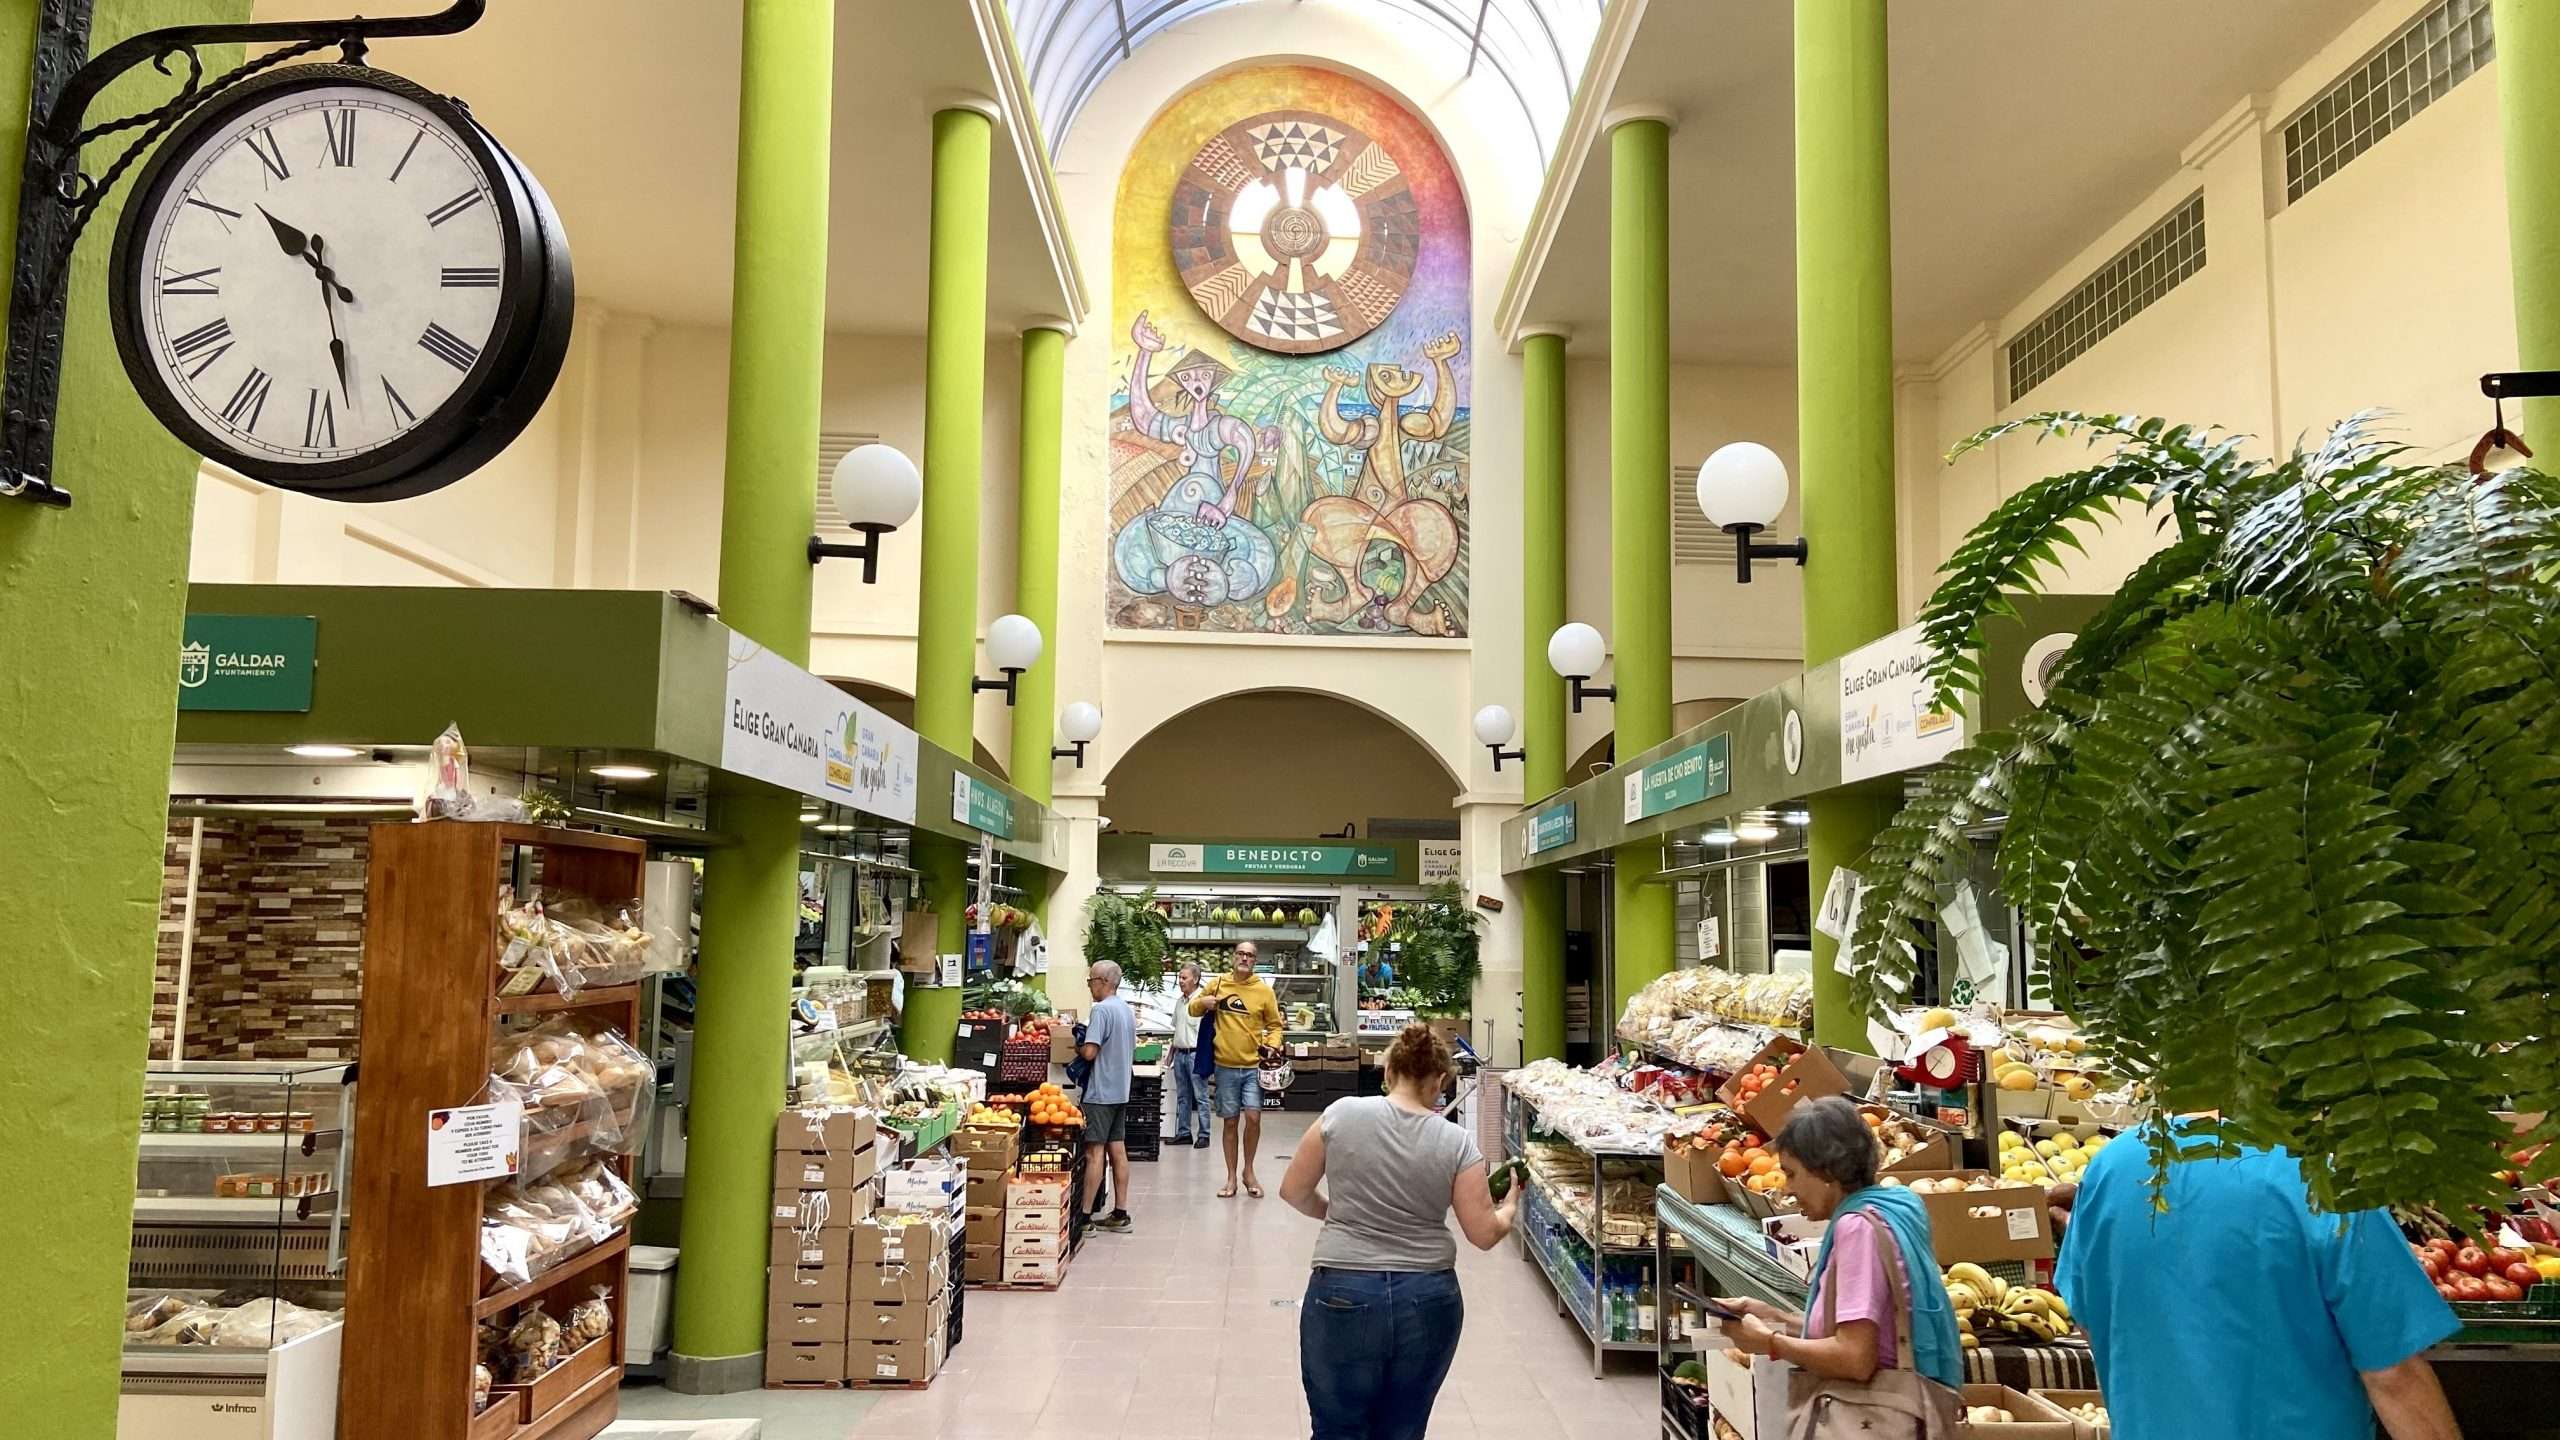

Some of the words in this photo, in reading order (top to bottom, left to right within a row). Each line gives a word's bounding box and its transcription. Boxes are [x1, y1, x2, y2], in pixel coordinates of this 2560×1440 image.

[215, 651, 286, 668] GÁLDAR
[214, 669, 276, 677] AYUNTAMIENTO
[1226, 849, 1322, 862] BENEDICTO
[225, 1403, 257, 1413] Infrico
